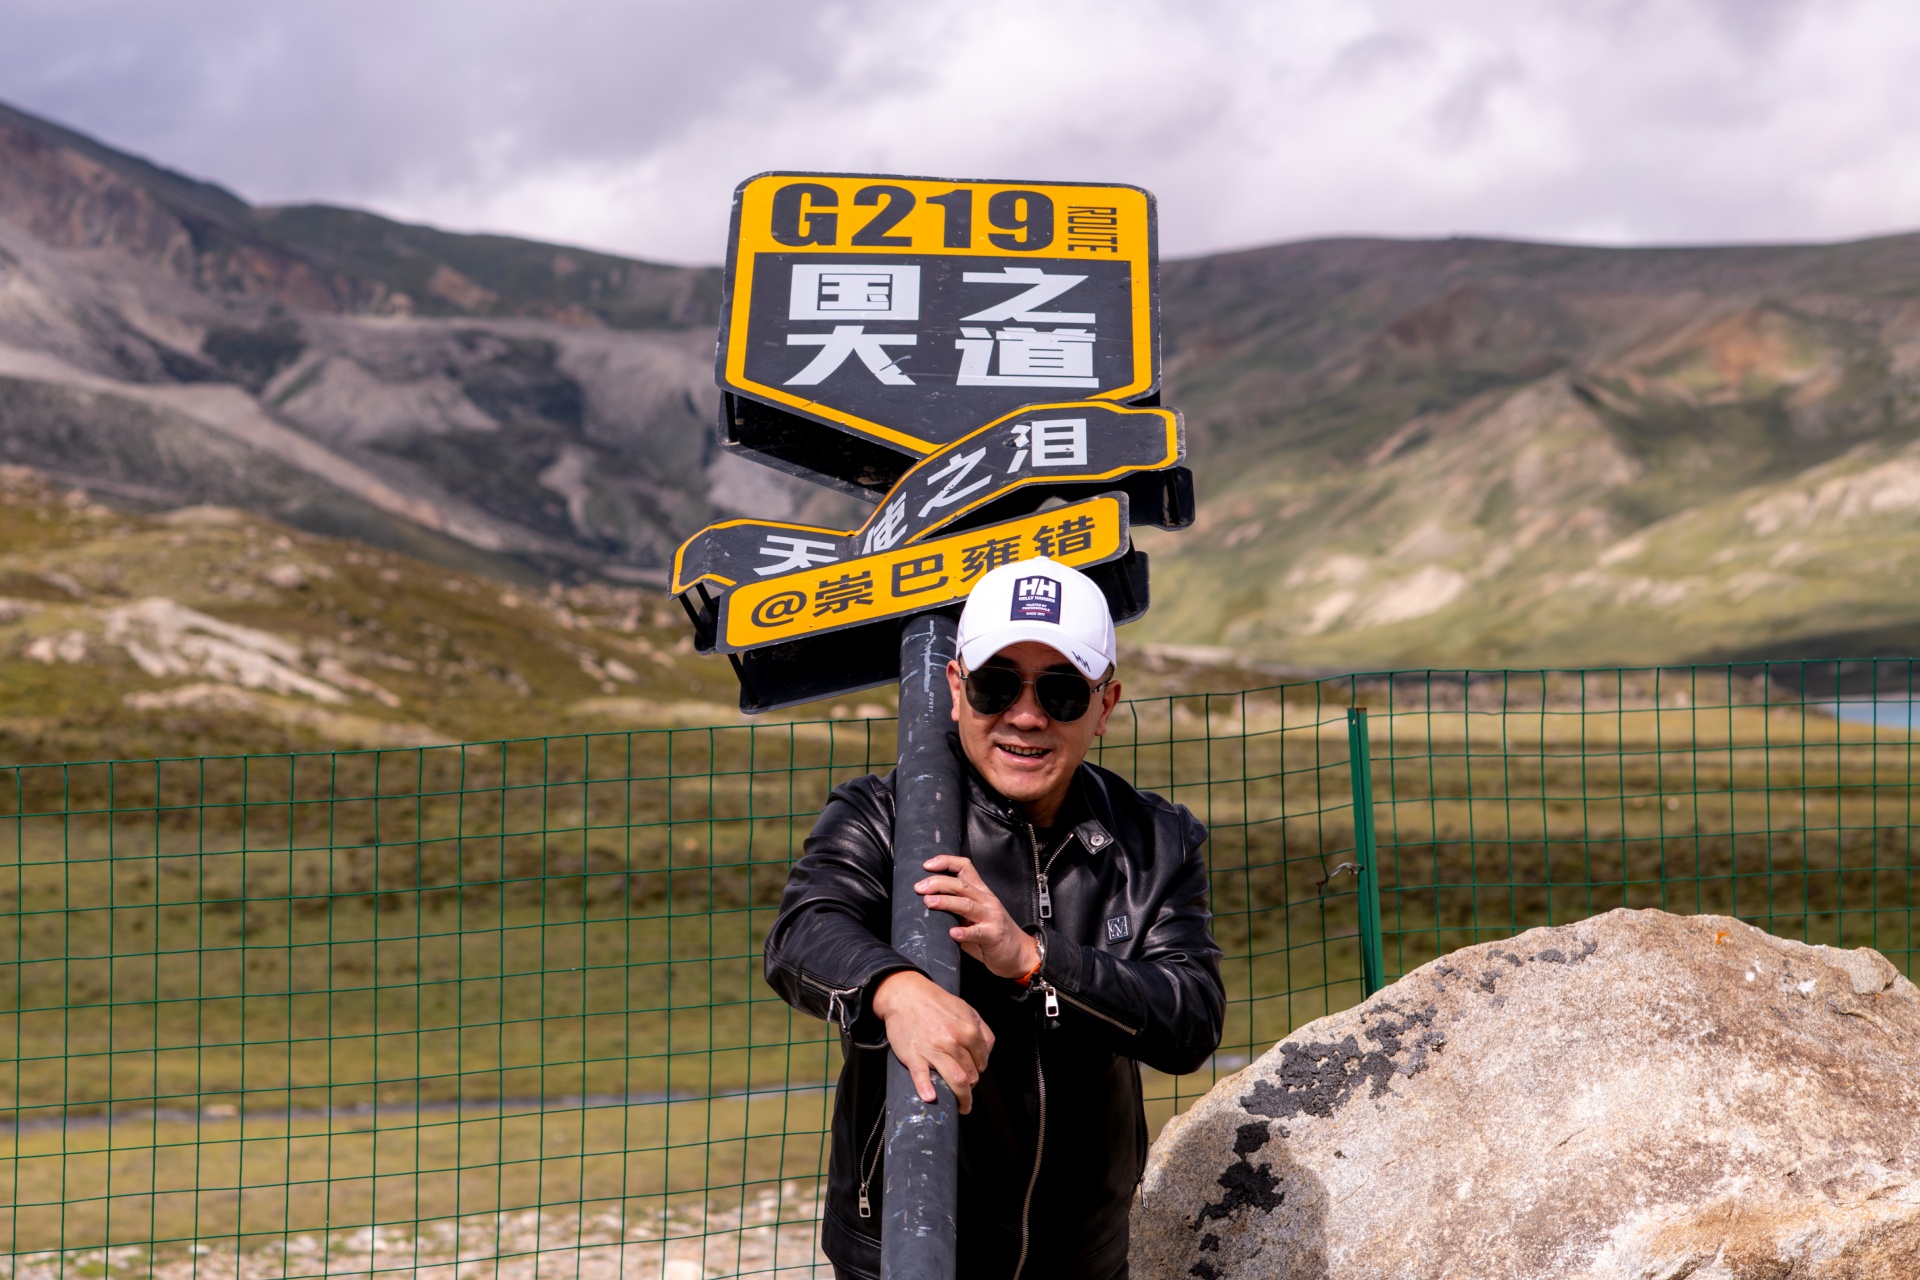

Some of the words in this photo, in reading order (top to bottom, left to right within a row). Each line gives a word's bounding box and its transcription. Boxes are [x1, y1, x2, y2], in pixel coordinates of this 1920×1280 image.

[771, 183, 1054, 251] G219
[1067, 206, 1118, 253] ROUTE
[788, 264, 1096, 324] 国之
[782, 325, 1100, 388] 大道
[753, 418, 1087, 576] 天使之泪
[1019, 578, 1056, 598] HH
